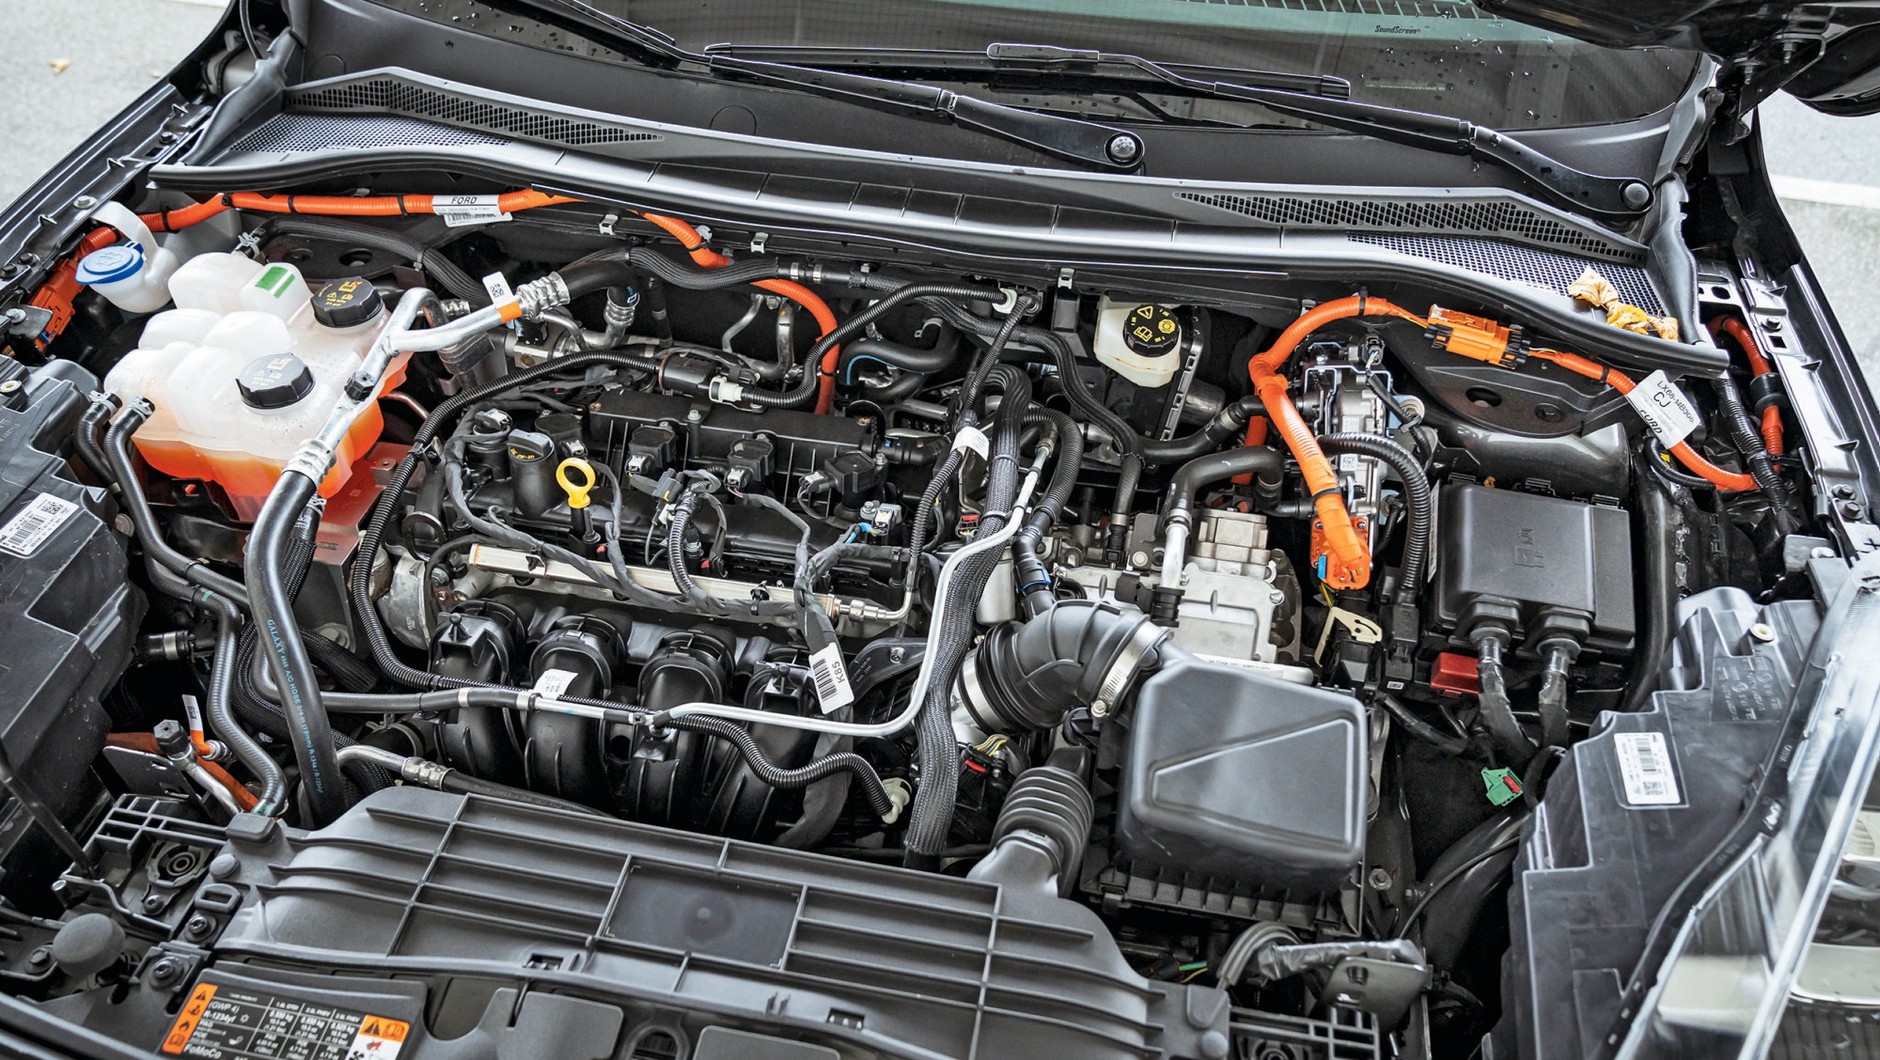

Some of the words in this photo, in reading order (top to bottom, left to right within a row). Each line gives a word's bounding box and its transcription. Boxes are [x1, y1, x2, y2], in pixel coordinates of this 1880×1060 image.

[1375, 25, 1418, 34] SoundScreen
[451, 196, 478, 204] FORD
[1653, 391, 1671, 408] CJ
[267, 619, 285, 655] GALAXY
[290, 683, 301, 705] HOSE
[831, 661, 846, 684] K85
[208, 1001, 231, 1012] (GWP
[183, 1044, 222, 1059] FoMoCo
